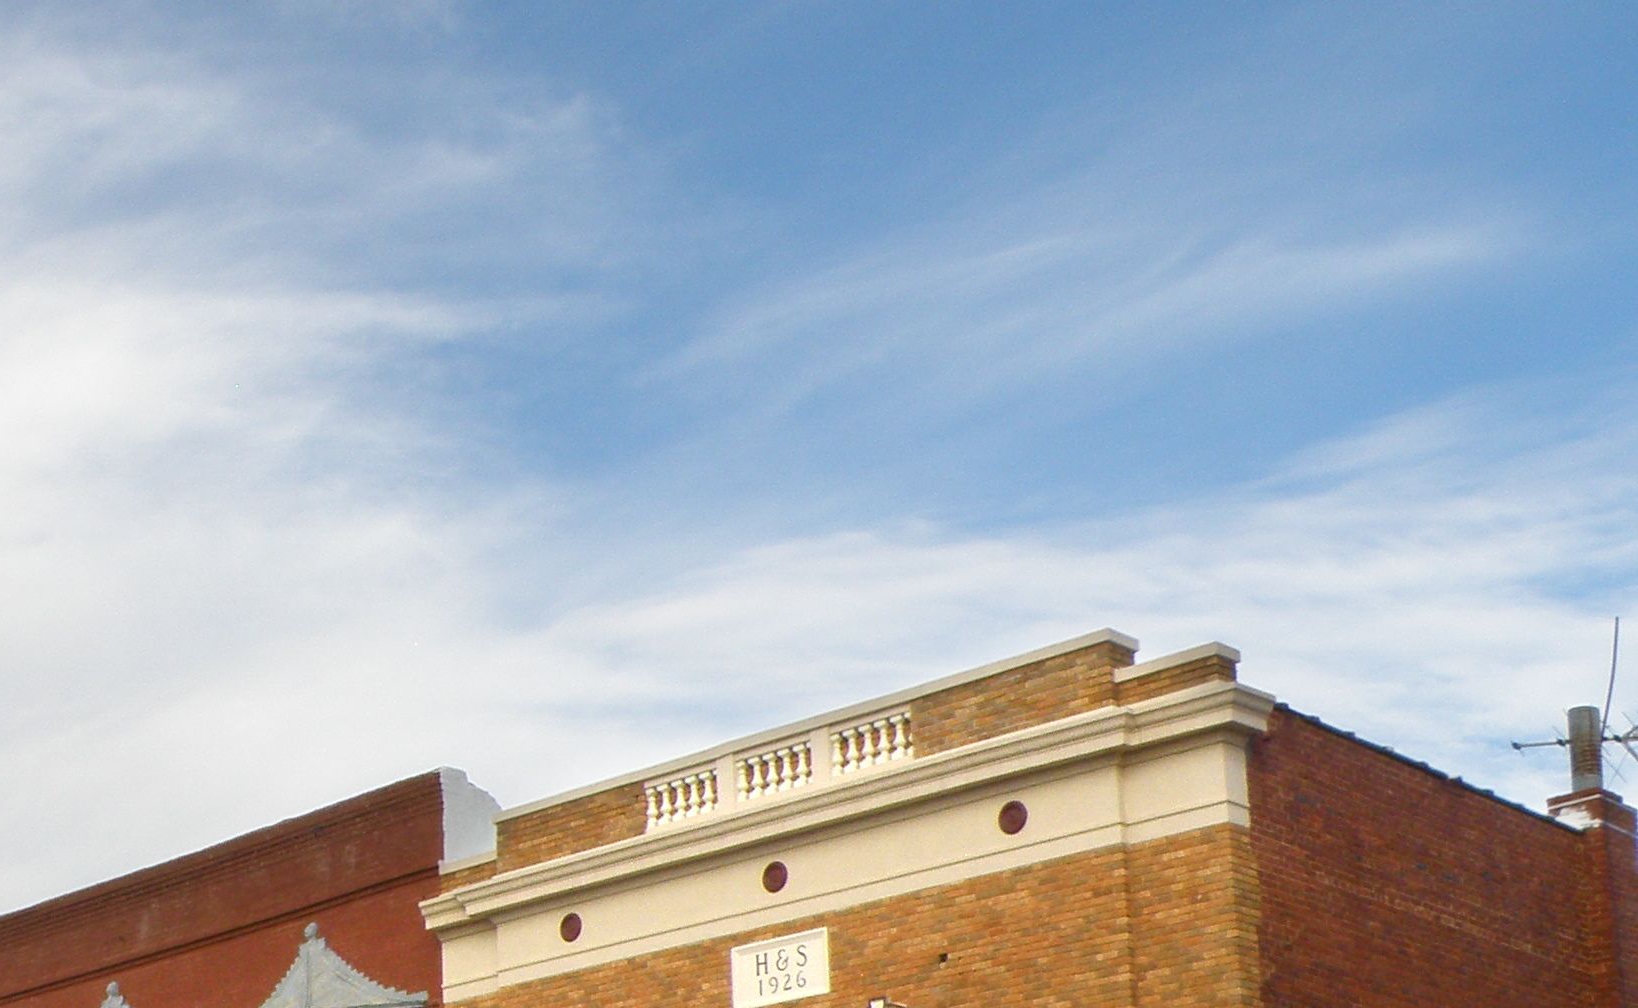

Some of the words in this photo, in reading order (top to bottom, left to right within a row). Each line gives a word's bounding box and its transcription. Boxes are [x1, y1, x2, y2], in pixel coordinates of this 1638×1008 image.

[755, 952, 769, 976] H
[775, 948, 790, 972] &
[796, 944, 808, 968] S
[759, 970, 807, 996] 1926
